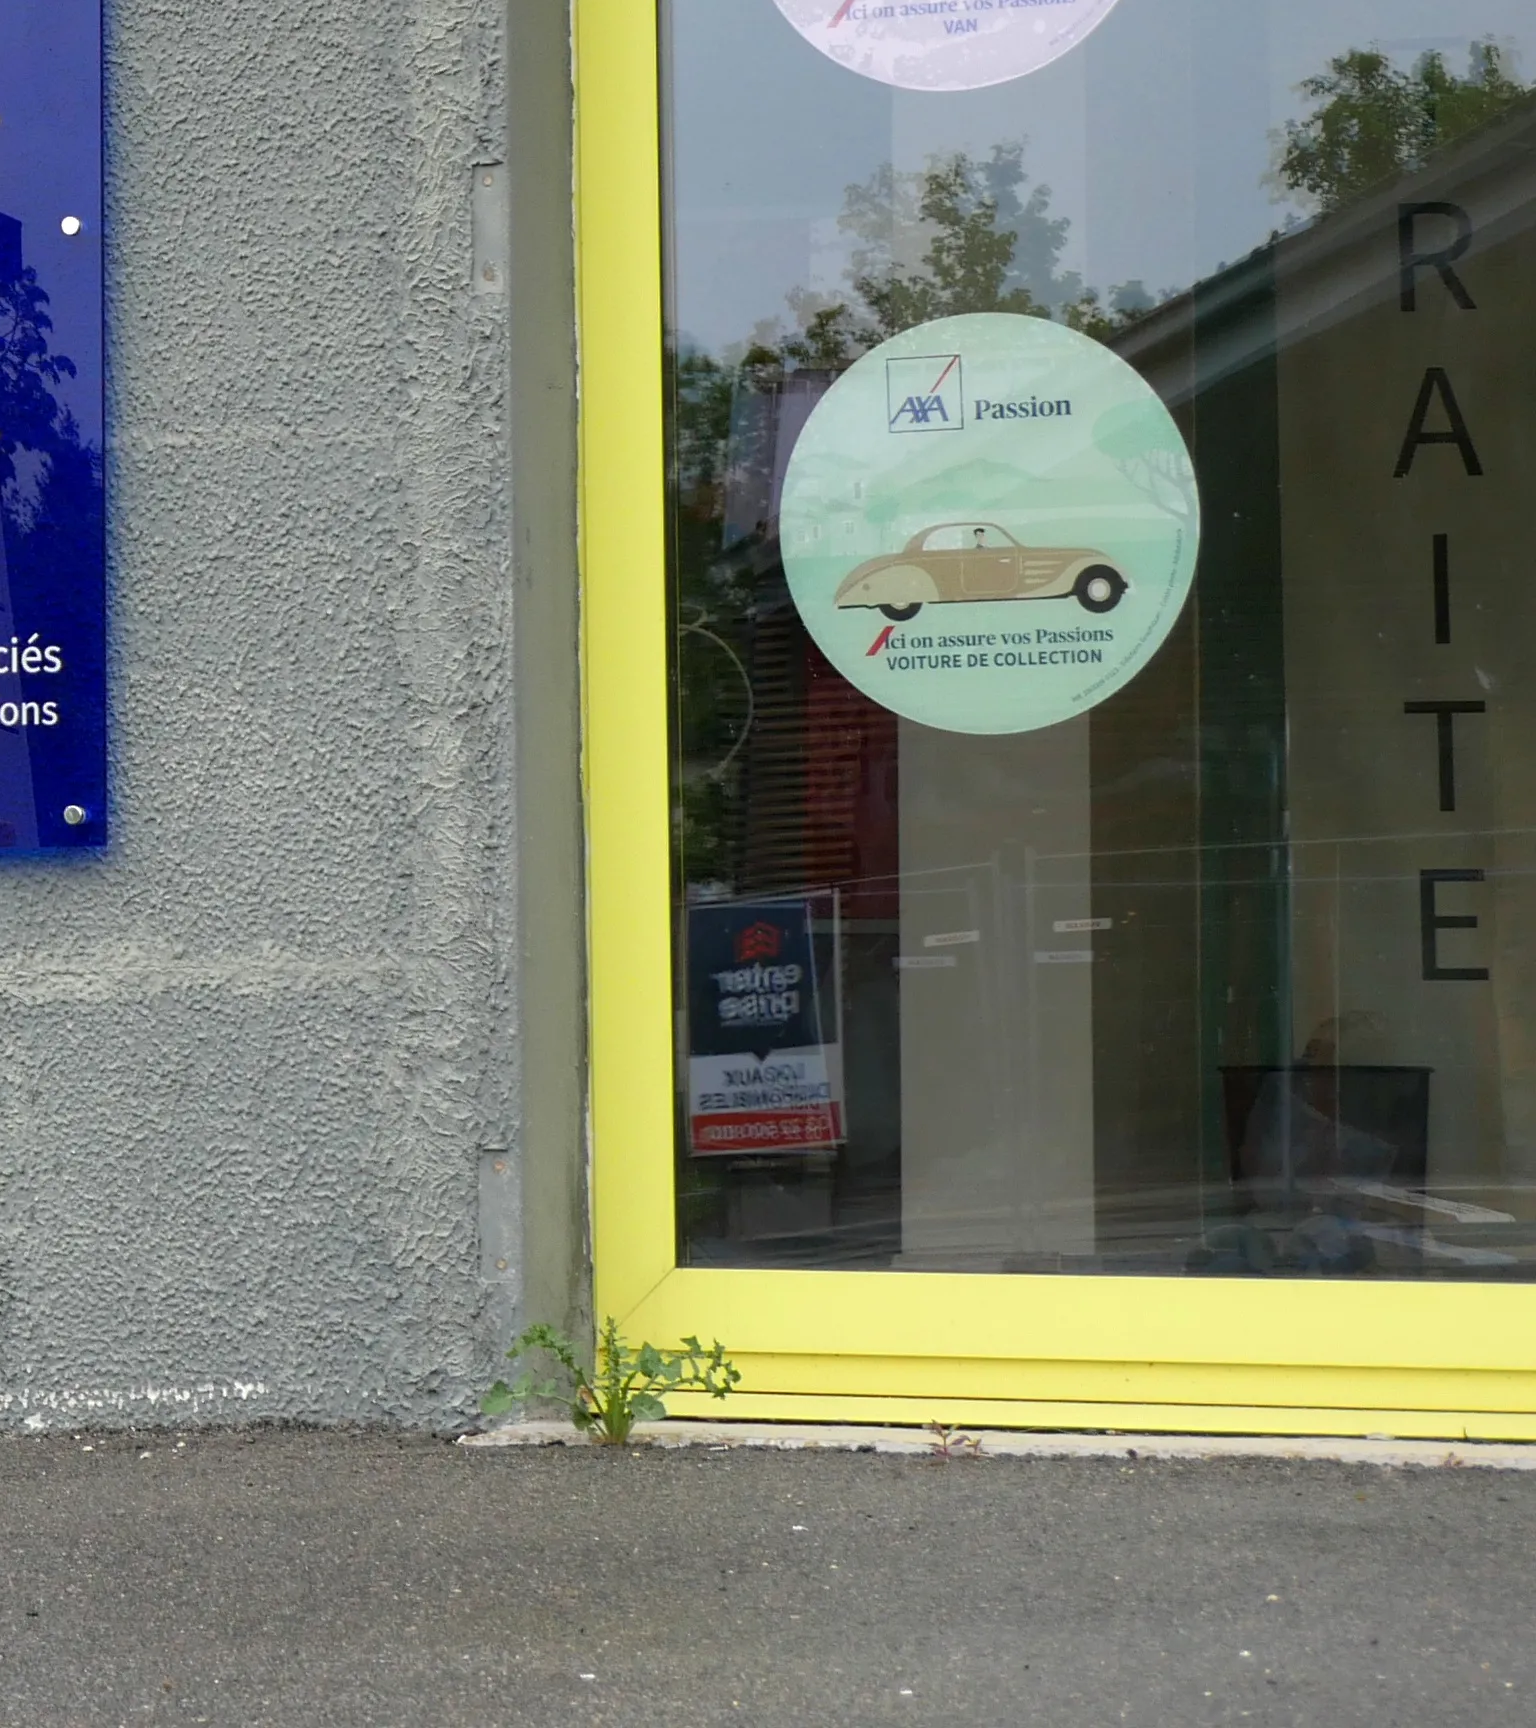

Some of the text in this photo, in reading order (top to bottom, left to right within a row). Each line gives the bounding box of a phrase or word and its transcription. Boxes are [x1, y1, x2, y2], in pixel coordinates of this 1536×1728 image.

[843, 1, 867, 22] Ici
[872, 3, 896, 19] on
[942, 17, 979, 35] VAN
[889, 393, 1072, 425] AXA Passion
[883, 625, 1114, 650] Ici on assure vos Passions
[887, 648, 1103, 671] VOITURE DE COLLECTION
